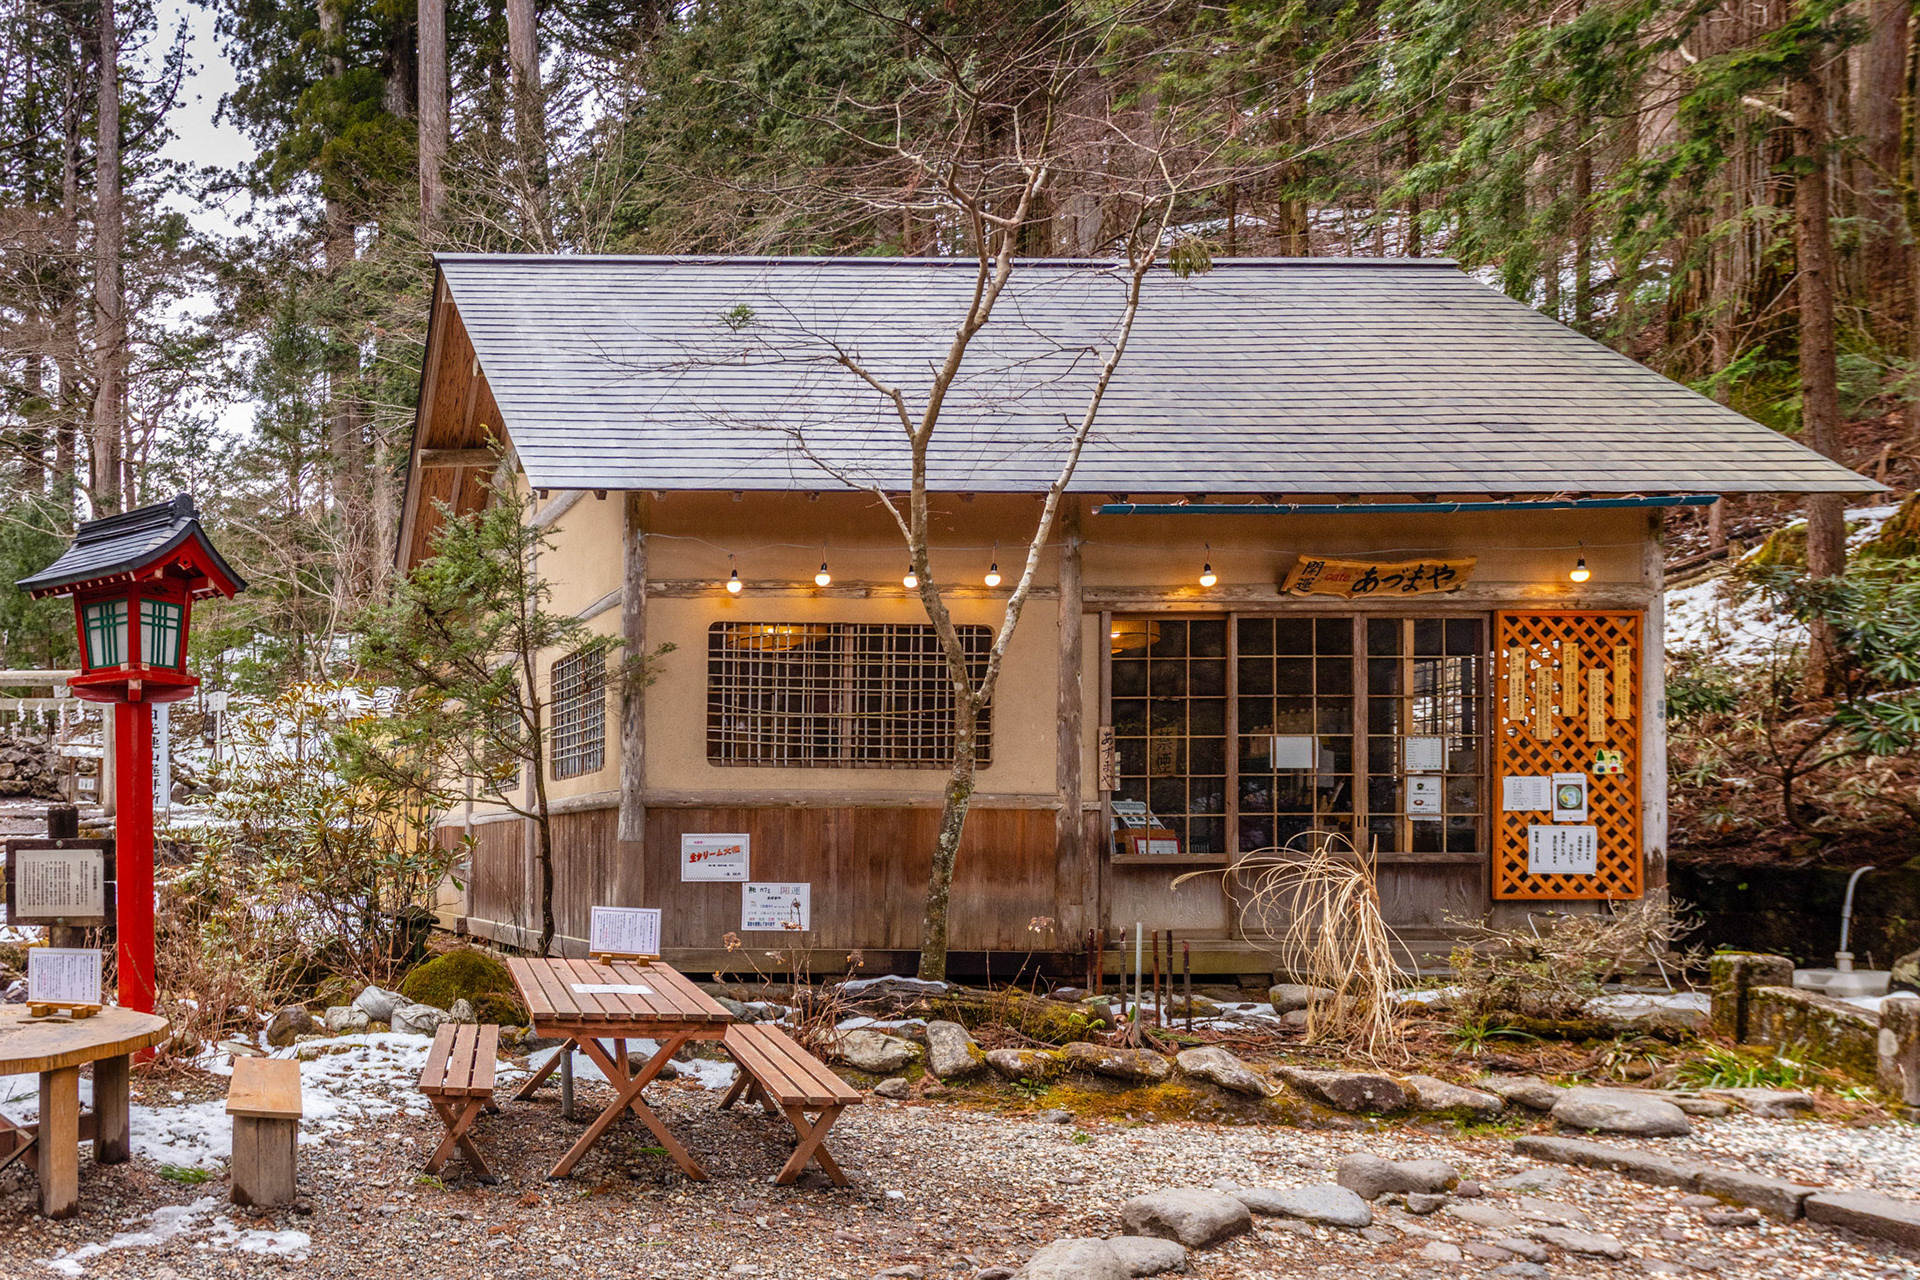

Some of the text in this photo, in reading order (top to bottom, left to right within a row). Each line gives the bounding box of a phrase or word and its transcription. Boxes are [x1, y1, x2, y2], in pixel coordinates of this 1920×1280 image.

[1295, 561, 1325, 592] 開運
[1325, 571, 1351, 582] cafe
[1351, 563, 1457, 593] あづまや
[1101, 731, 1115, 789] あずまや
[1156, 729, 1173, 774] 禁煙
[689, 845, 741, 863] 生クリーム大福
